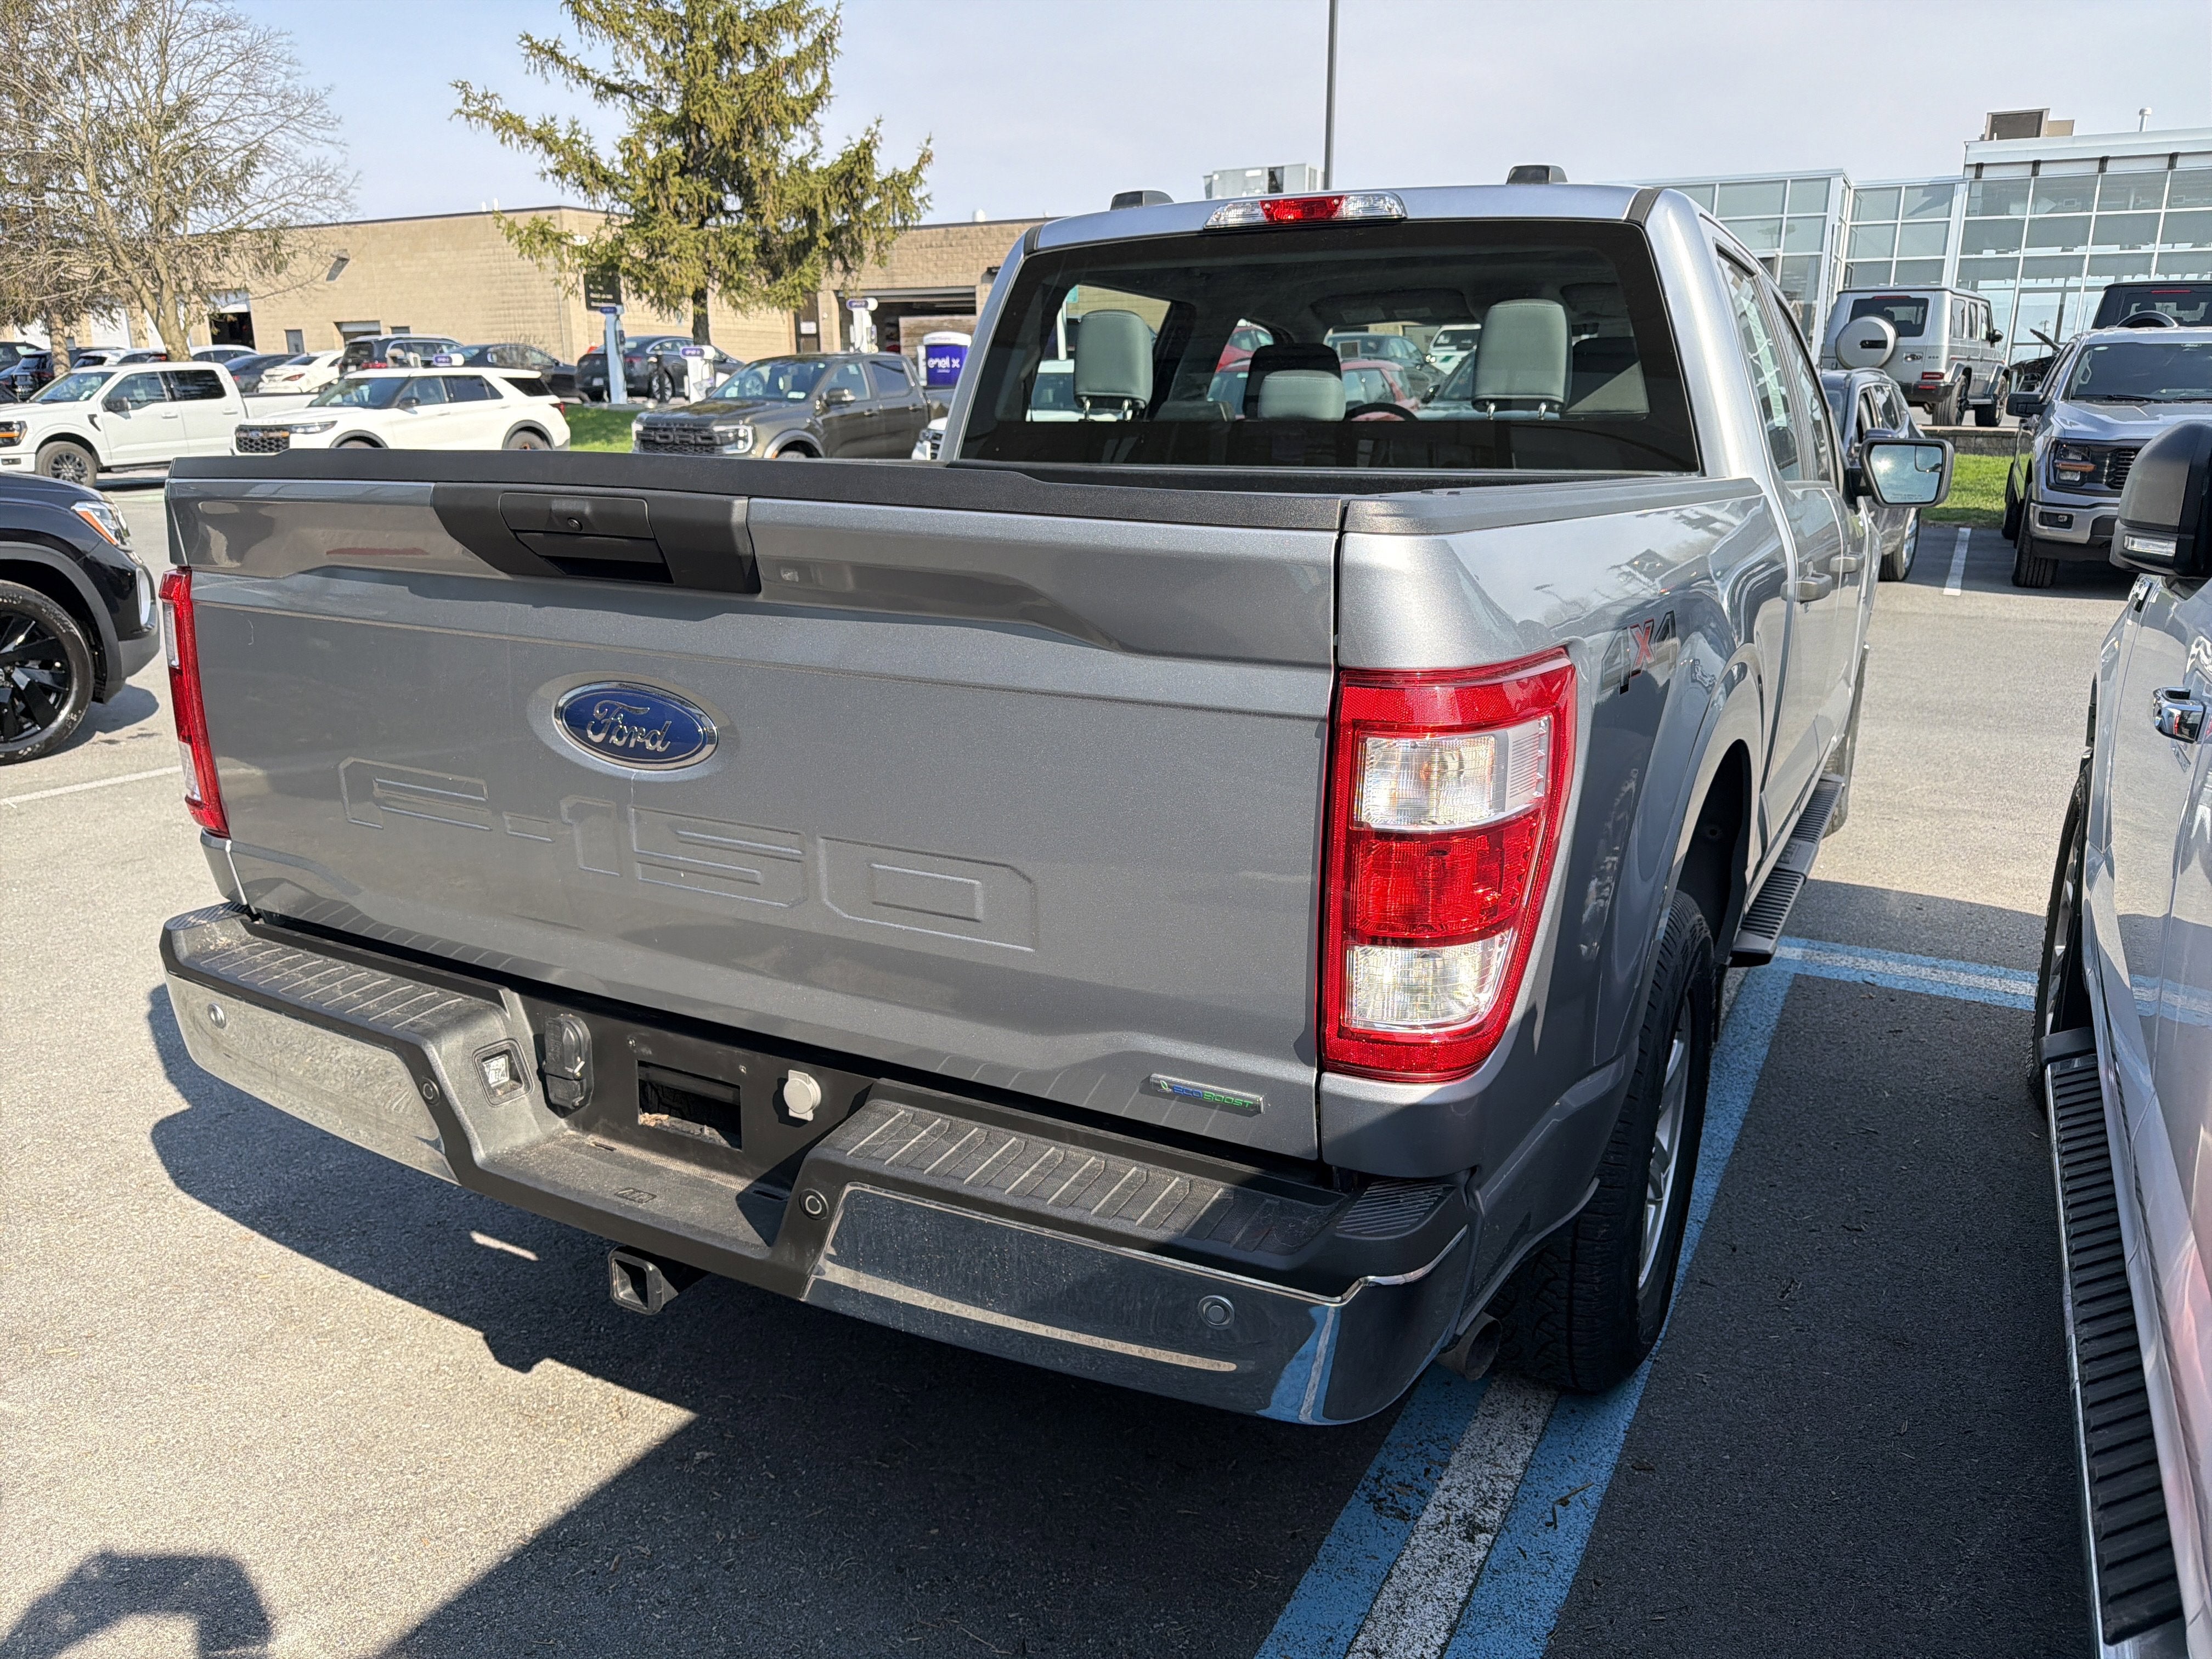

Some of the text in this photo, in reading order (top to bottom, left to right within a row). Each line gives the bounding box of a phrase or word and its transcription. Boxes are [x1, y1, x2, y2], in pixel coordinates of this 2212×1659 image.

[927, 355, 950, 369] enel
[636, 431, 715, 445] FORD
[586, 699, 671, 753] Ford
[338, 756, 1037, 953] F-150
[1172, 1084, 1254, 1109] ECOBOOST
